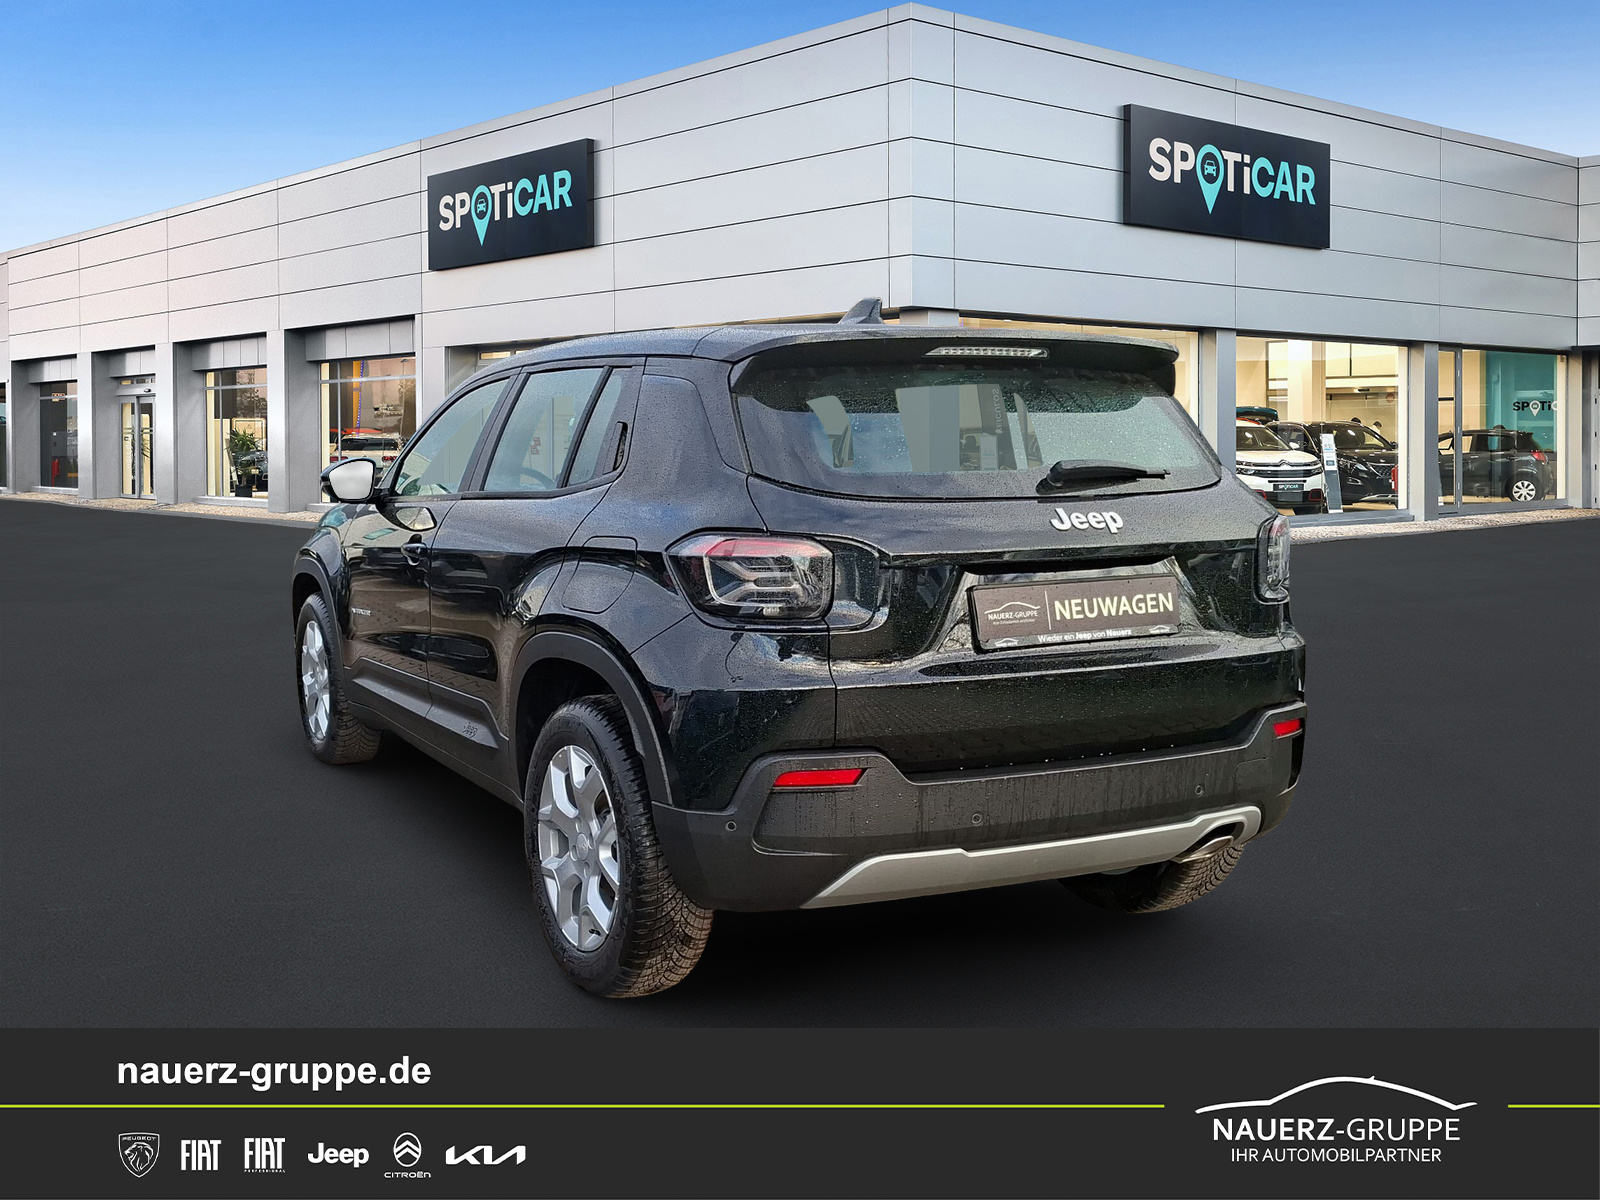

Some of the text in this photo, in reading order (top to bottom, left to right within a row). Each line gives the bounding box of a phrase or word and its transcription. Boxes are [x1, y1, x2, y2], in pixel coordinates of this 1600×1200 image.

[1050, 507, 1124, 534] Jeep
[988, 610, 1038, 620] NAUERZ-GRUPPE
[1054, 592, 1174, 620] NEUWAGEN
[1037, 634, 1063, 643] Wieder
[1063, 633, 1075, 641] ein
[1075, 631, 1092, 640] Jeep
